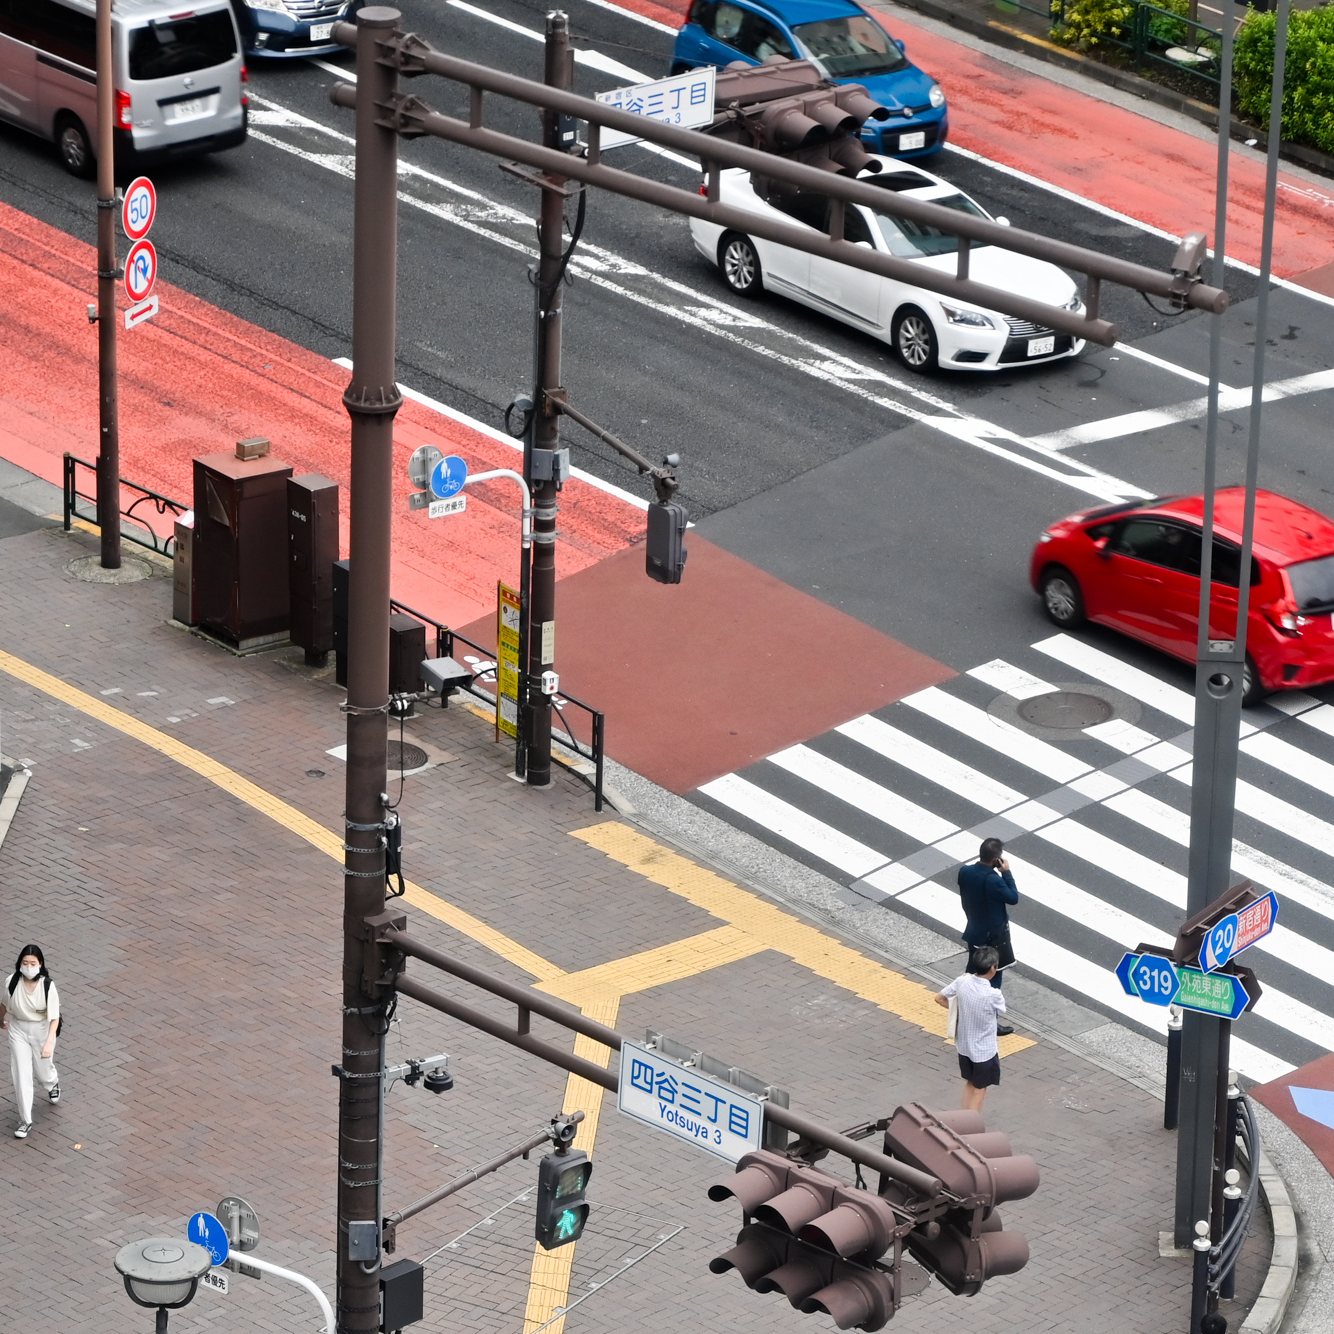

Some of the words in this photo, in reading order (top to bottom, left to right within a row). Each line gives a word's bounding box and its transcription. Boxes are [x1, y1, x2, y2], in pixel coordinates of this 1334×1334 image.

[130, 194, 148, 224] 50
[431, 500, 464, 515] 歩行者優先
[1238, 901, 1269, 935] 新宿通り
[1214, 923, 1234, 957] 20
[1139, 966, 1172, 995] 319
[1181, 972, 1230, 1000] 外苑東通り
[631, 1059, 749, 1139] 四谷三丁目
[658, 1102, 708, 1139] Yotsuya
[713, 1129, 722, 1145] 3
